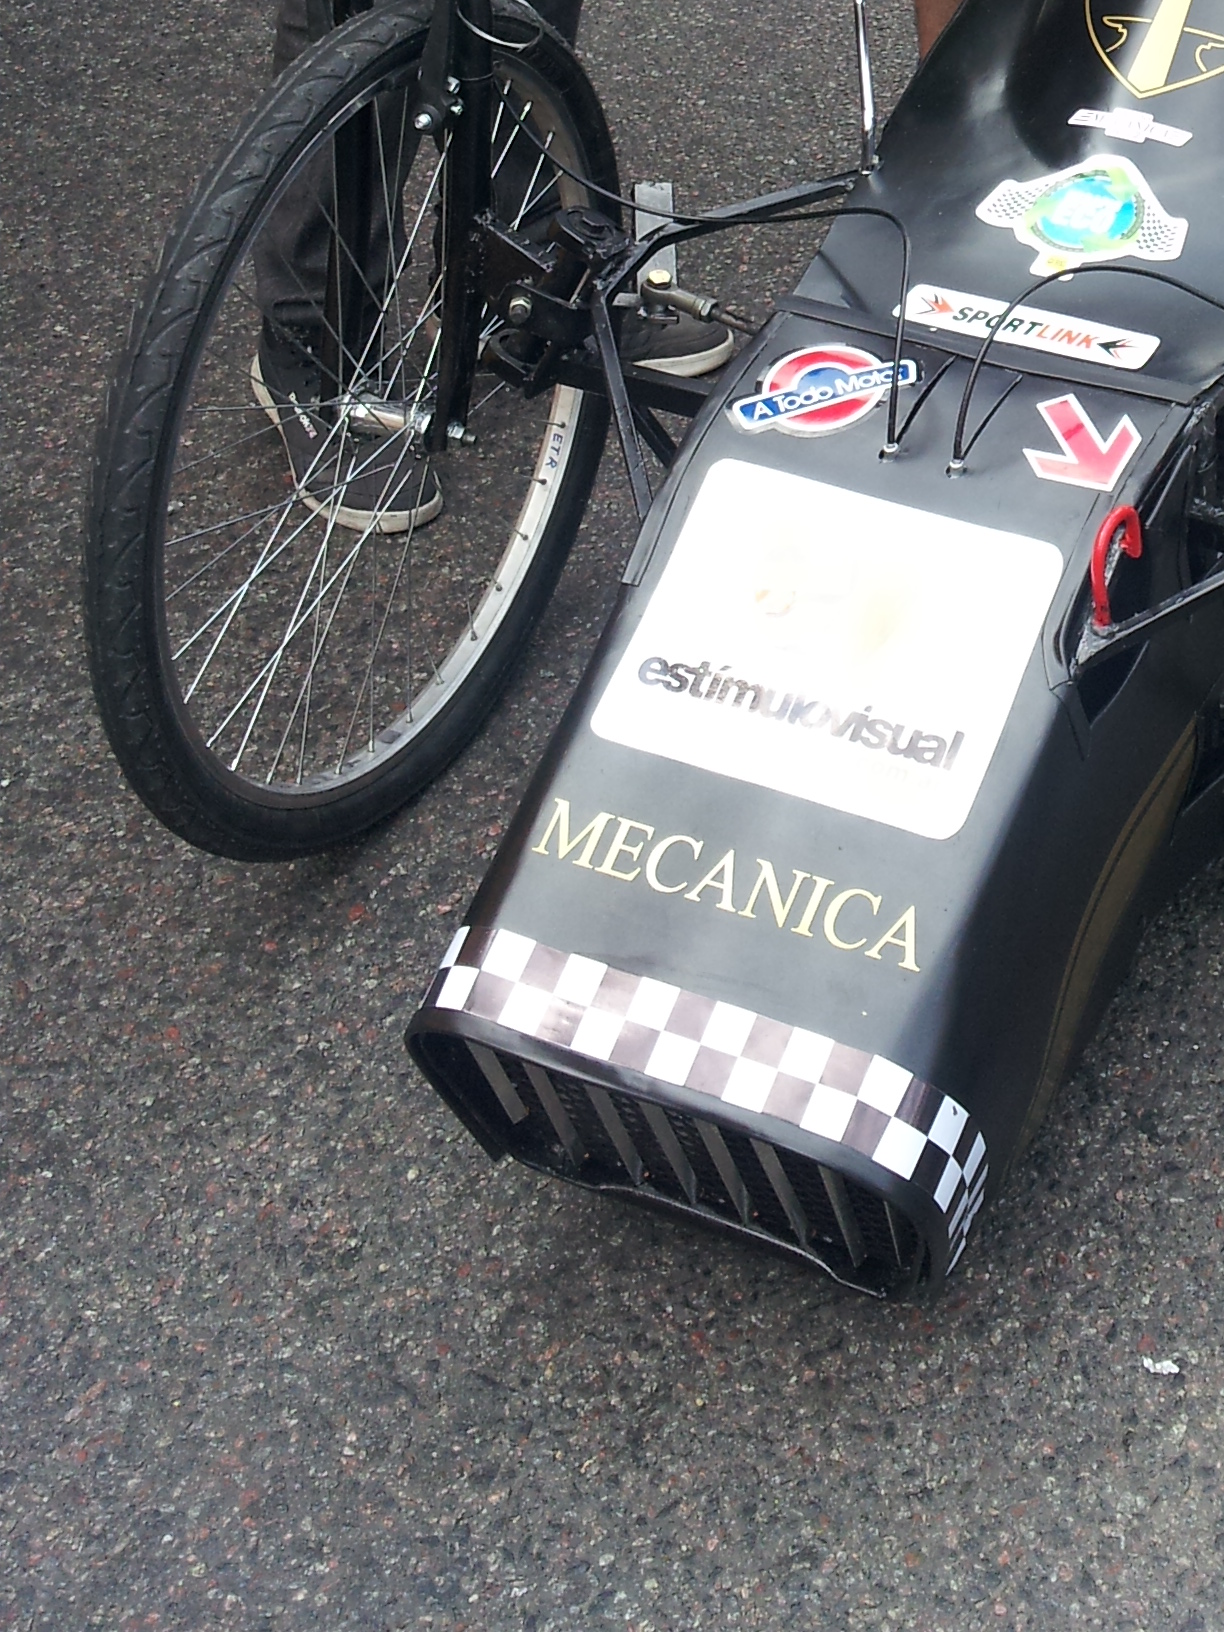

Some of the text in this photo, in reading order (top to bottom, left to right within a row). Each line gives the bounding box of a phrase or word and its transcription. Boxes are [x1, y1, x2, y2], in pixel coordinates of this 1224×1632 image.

[952, 306, 1100, 350] SPORTLINK
[753, 399, 774, 421] A
[772, 386, 834, 413] Todo
[545, 432, 564, 469] ETR
[531, 797, 921, 973] MECANICA
